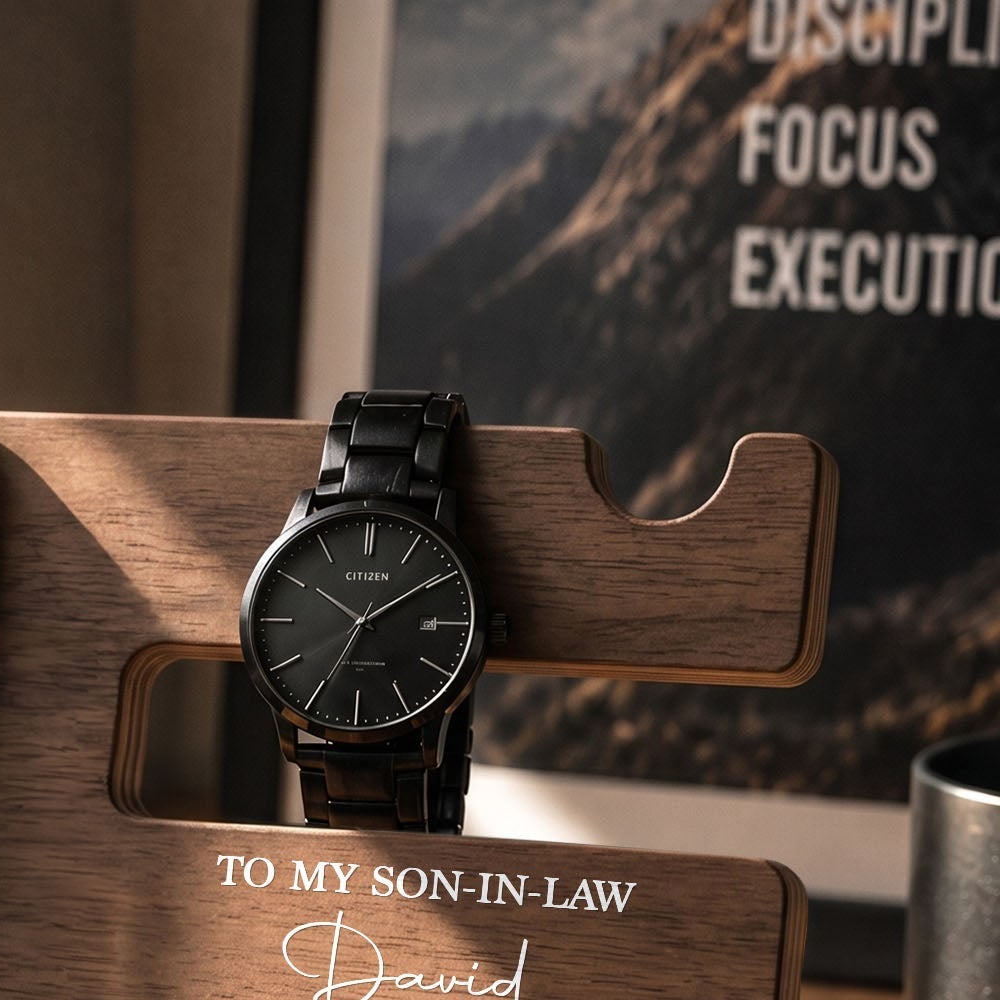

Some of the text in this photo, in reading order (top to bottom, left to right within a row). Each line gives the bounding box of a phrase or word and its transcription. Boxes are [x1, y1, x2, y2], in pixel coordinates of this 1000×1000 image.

[738, 102, 939, 191] FOCUS
[345, 571, 390, 581] CITIZEN
[216, 854, 638, 914] TO MY SON-IN-LAW
